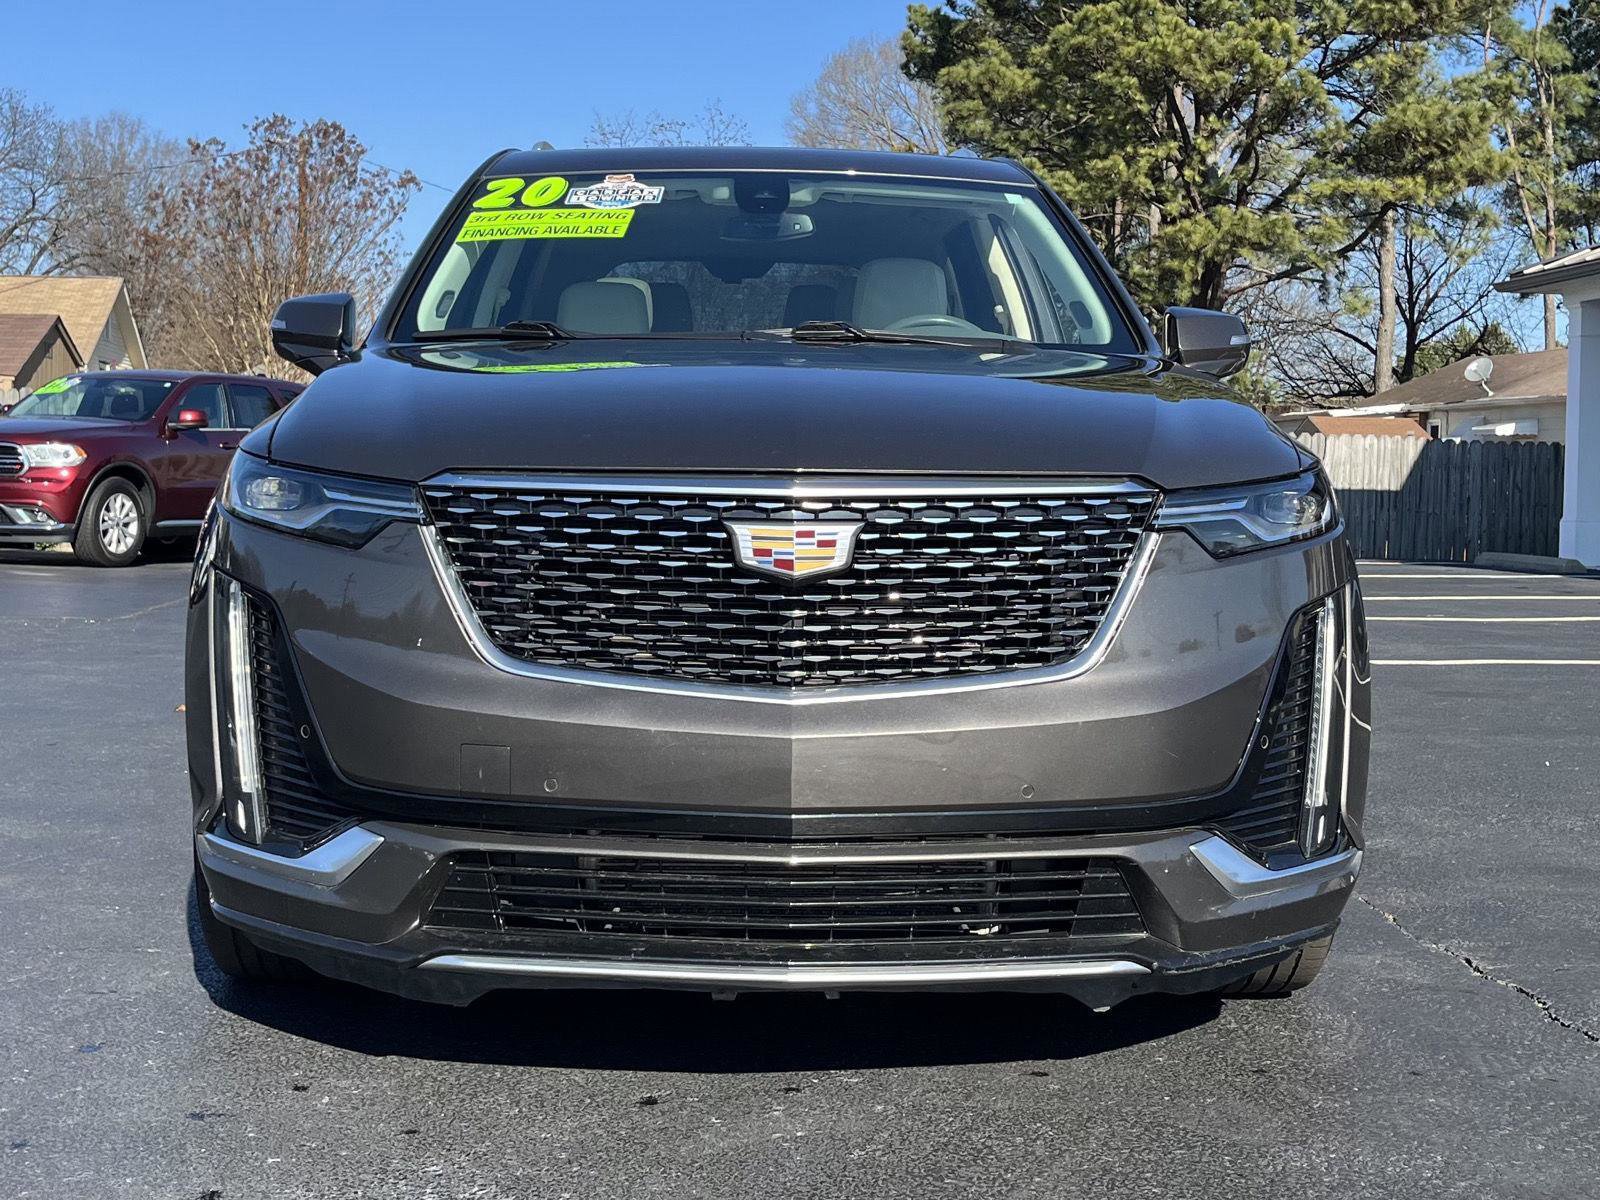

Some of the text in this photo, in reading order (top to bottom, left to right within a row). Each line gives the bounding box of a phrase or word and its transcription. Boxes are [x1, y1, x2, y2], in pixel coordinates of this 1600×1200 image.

[472, 176, 569, 209] 20
[469, 211, 630, 223] 3rd ROW SEATING
[462, 225, 623, 239] FINANCING AVAILABLE
